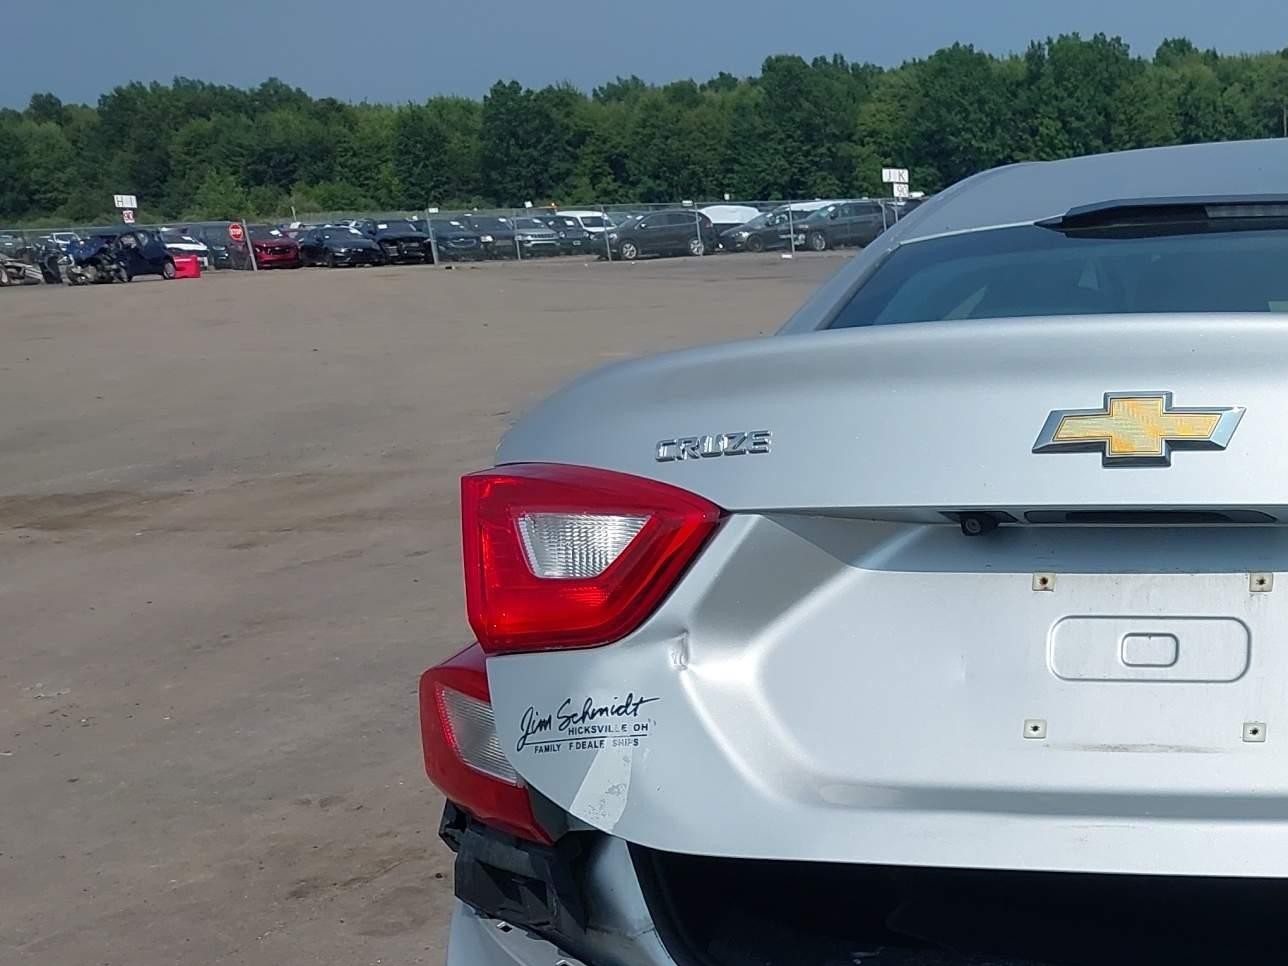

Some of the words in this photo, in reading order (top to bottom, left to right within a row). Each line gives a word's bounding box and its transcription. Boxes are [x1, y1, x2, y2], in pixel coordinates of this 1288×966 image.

[656, 430, 771, 462] CRUZE
[517, 706, 552, 752] Jim
[556, 692, 660, 732] Schmidt
[633, 723, 649, 732] OH
[534, 743, 561, 754] FAMILY
